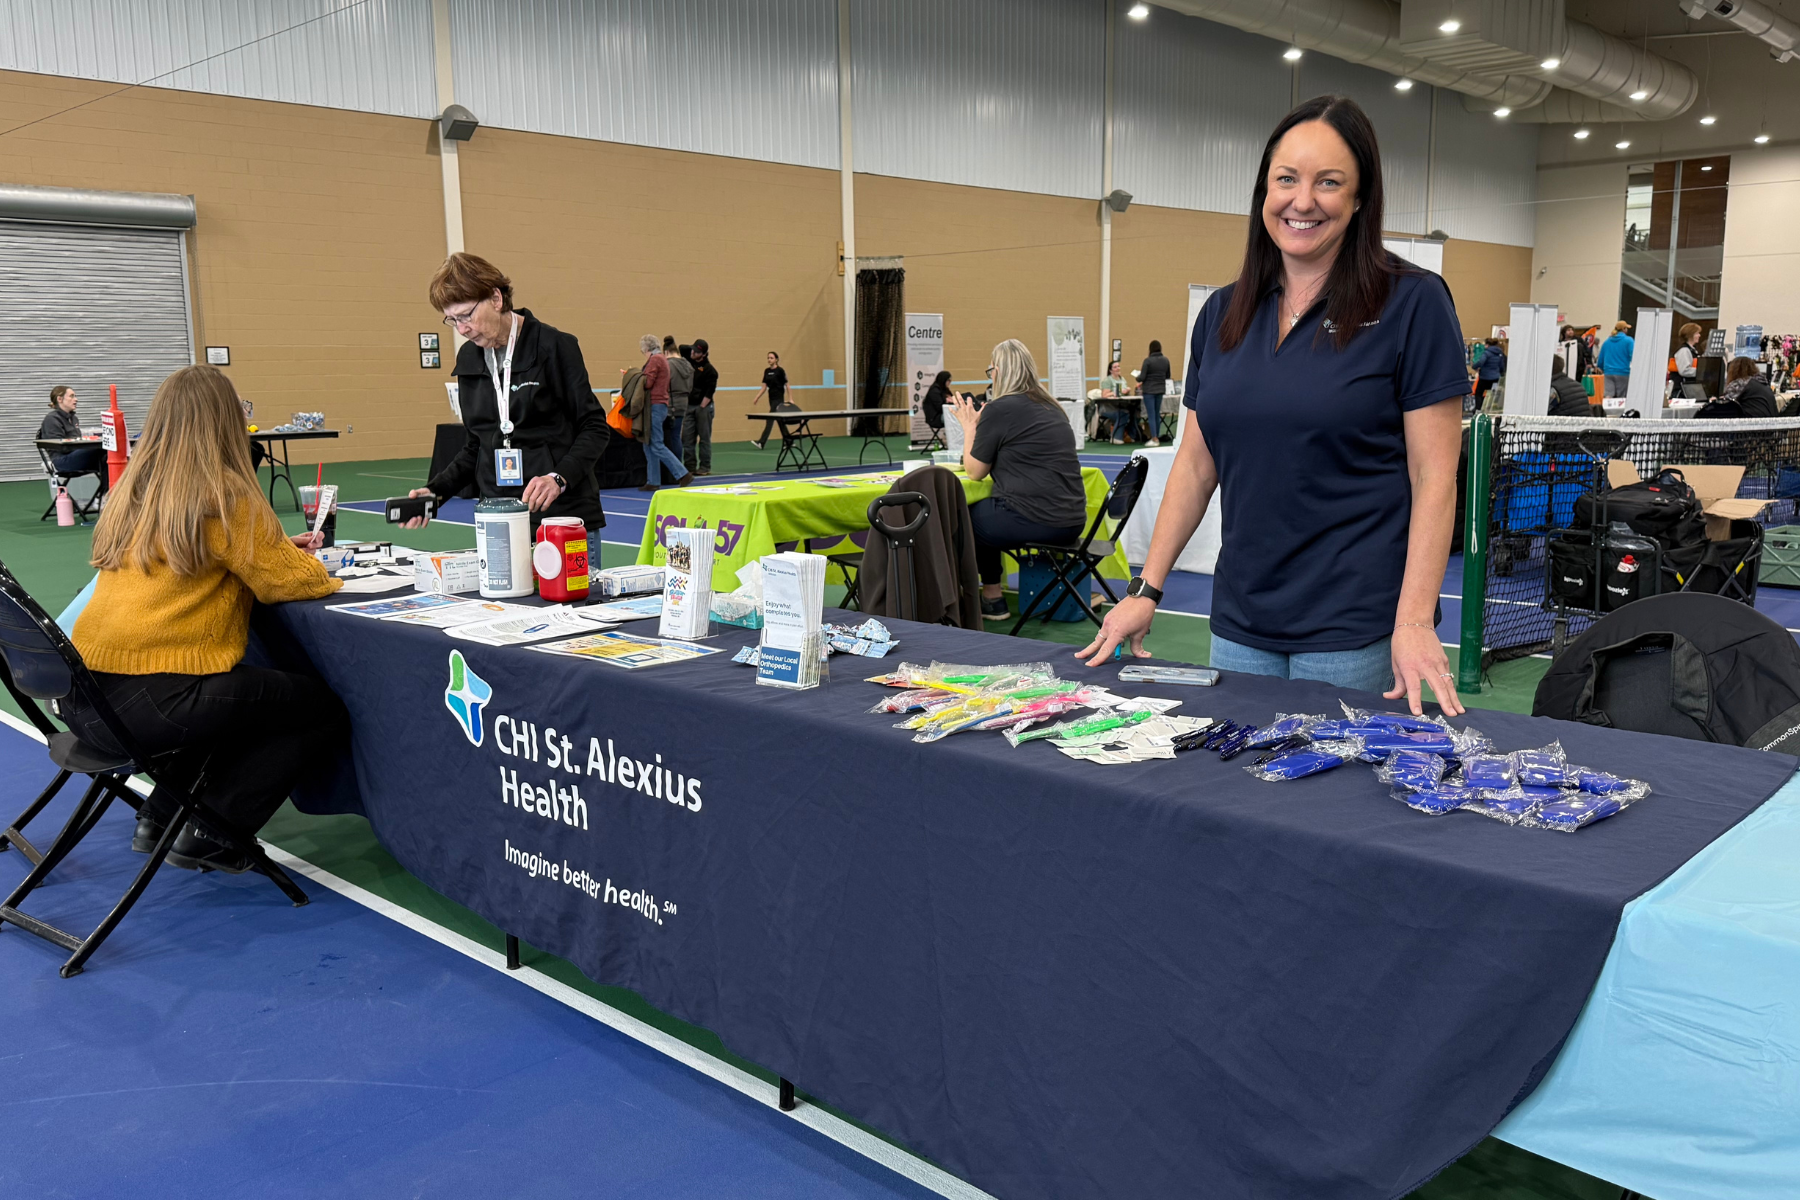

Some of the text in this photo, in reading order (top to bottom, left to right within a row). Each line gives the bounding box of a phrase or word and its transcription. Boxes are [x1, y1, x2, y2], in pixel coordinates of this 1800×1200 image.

[908, 325, 943, 339] Centre
[424, 338, 429, 346] 3
[425, 356, 431, 364] 3
[765, 600, 779, 609] Enjoy
[761, 652, 774, 661] Meet
[784, 654, 798, 664] Local
[760, 660, 792, 671] Orthopedics
[759, 668, 774, 676] Team
[494, 714, 703, 813] CHI St. Alexius
[499, 765, 588, 830] Health
[505, 839, 559, 881] Imagine
[563, 859, 600, 899] better
[603, 878, 663, 926] health.
